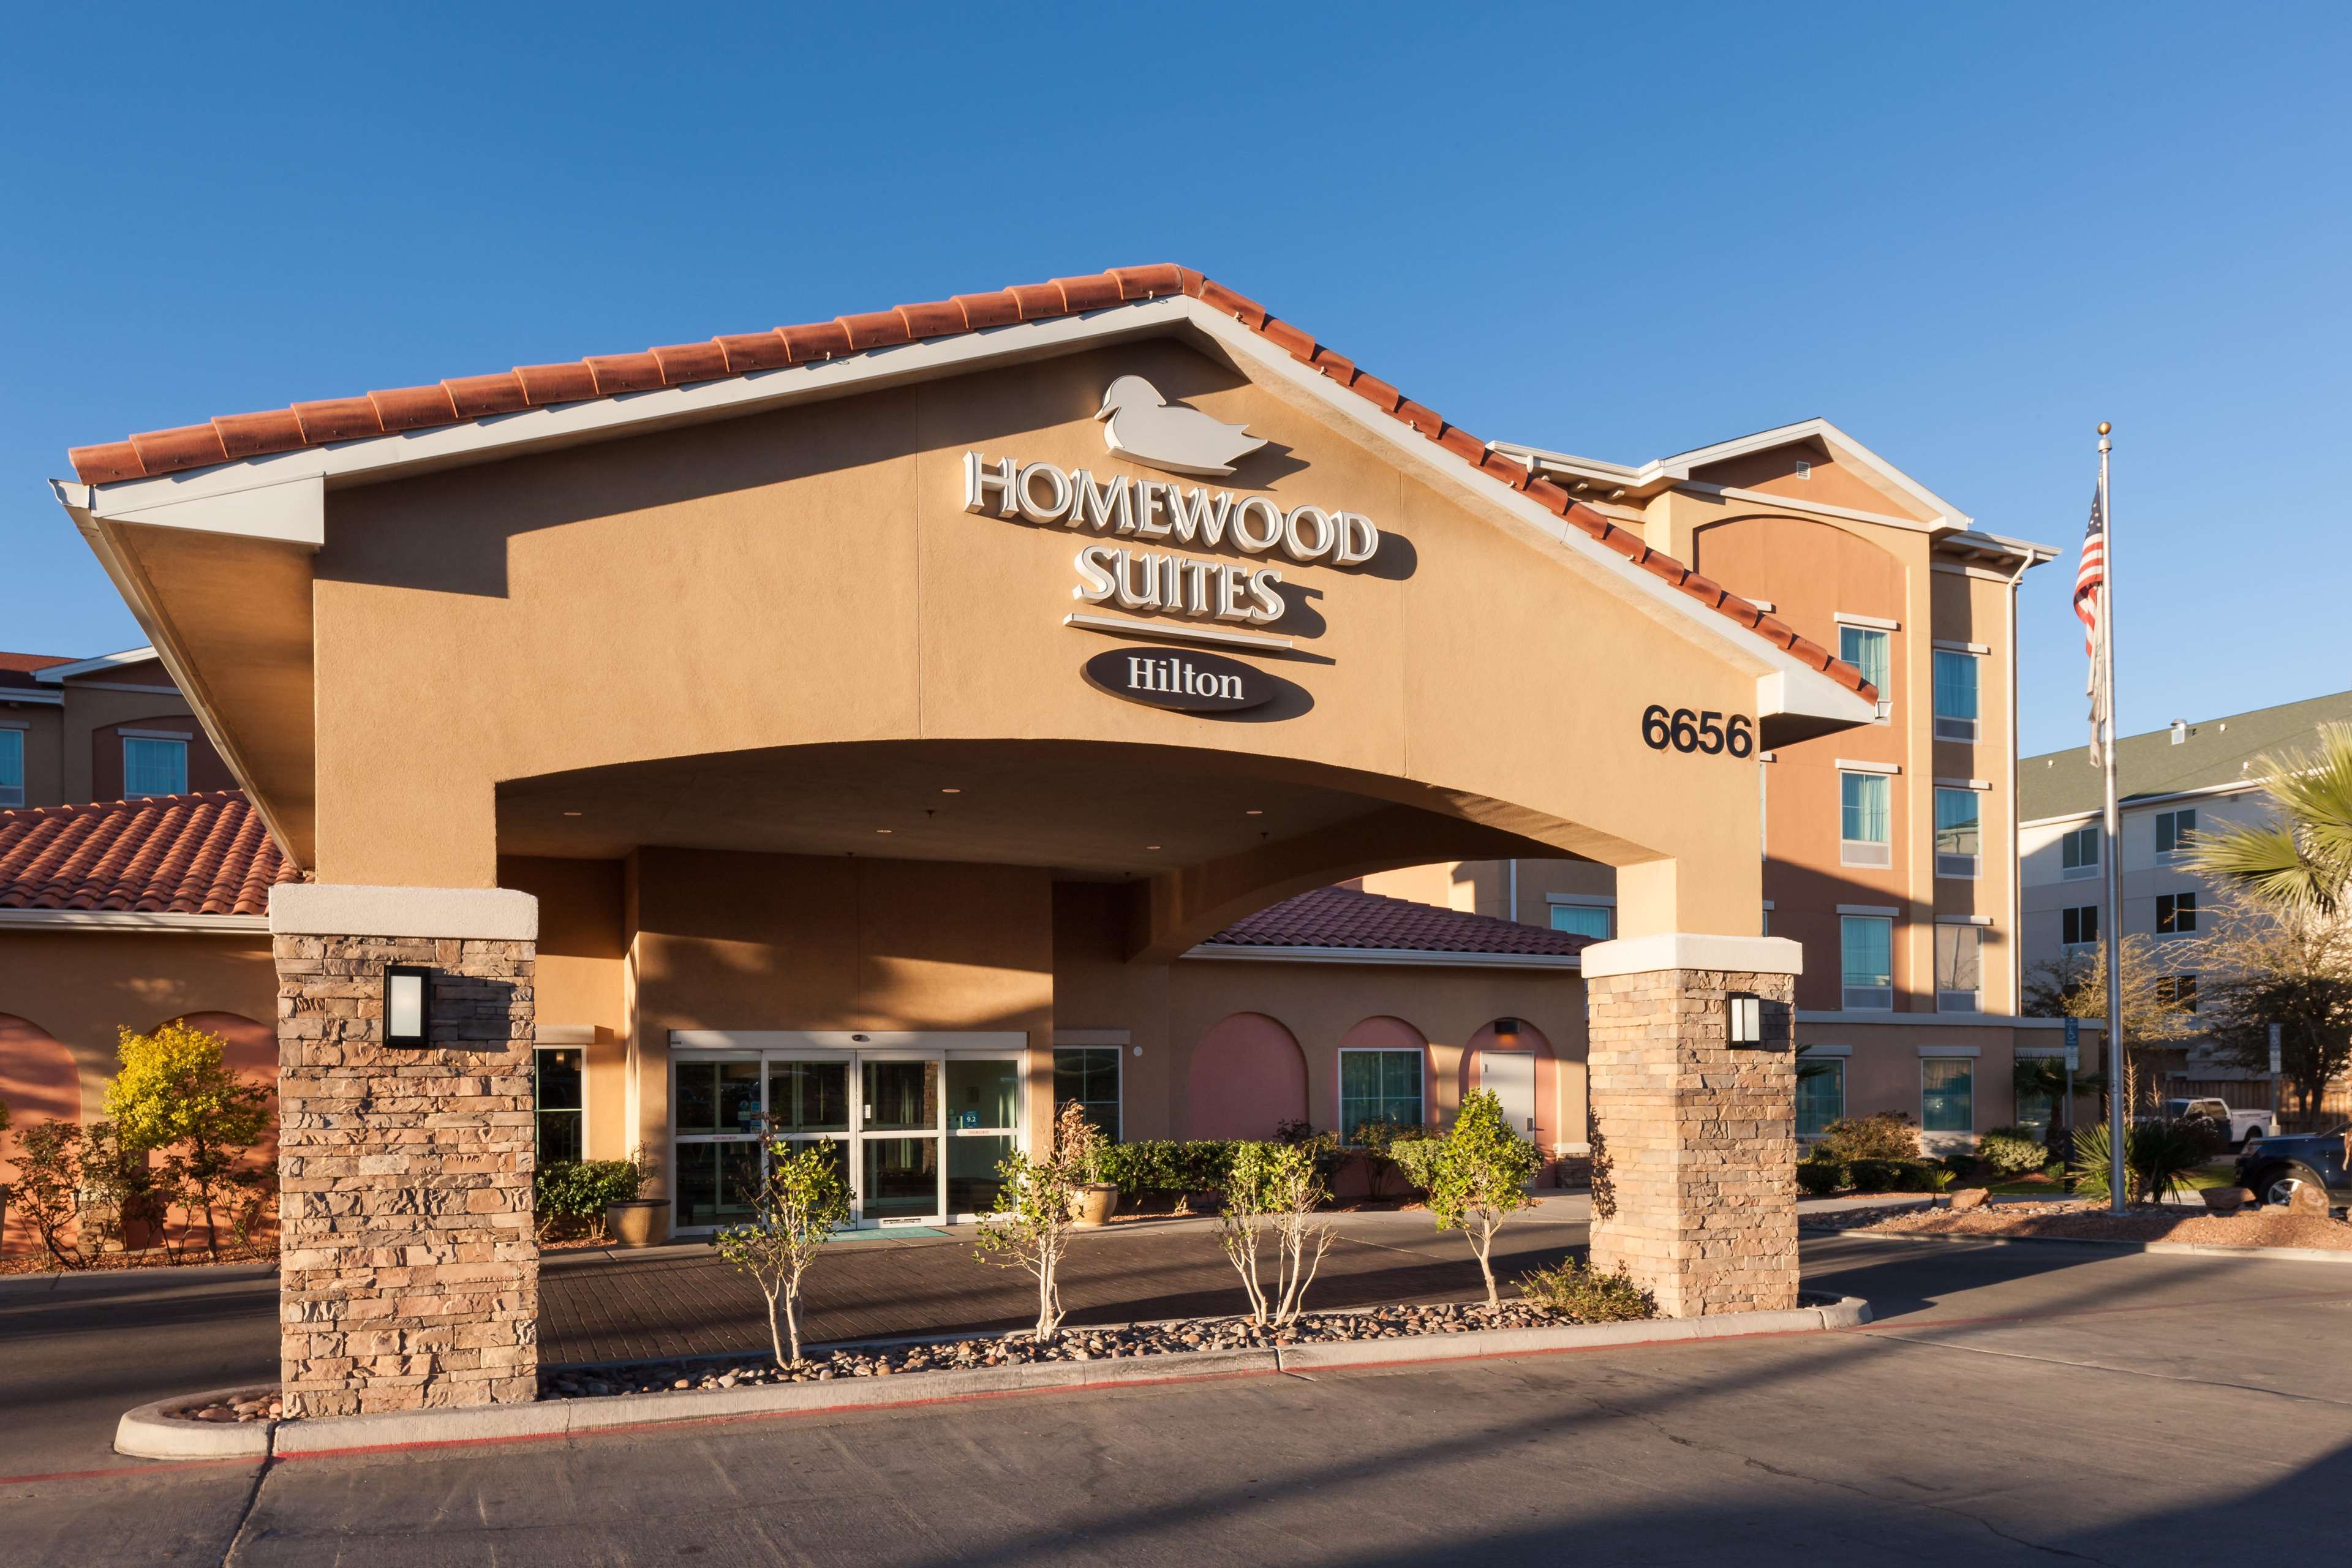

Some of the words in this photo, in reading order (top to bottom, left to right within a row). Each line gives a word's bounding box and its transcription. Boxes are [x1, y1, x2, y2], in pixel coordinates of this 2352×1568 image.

[962, 451, 1379, 566] HOMEWOOD
[1072, 545, 1286, 625] SUITES
[1127, 657, 1244, 701] Hilton
[1642, 704, 1752, 758] 6656
